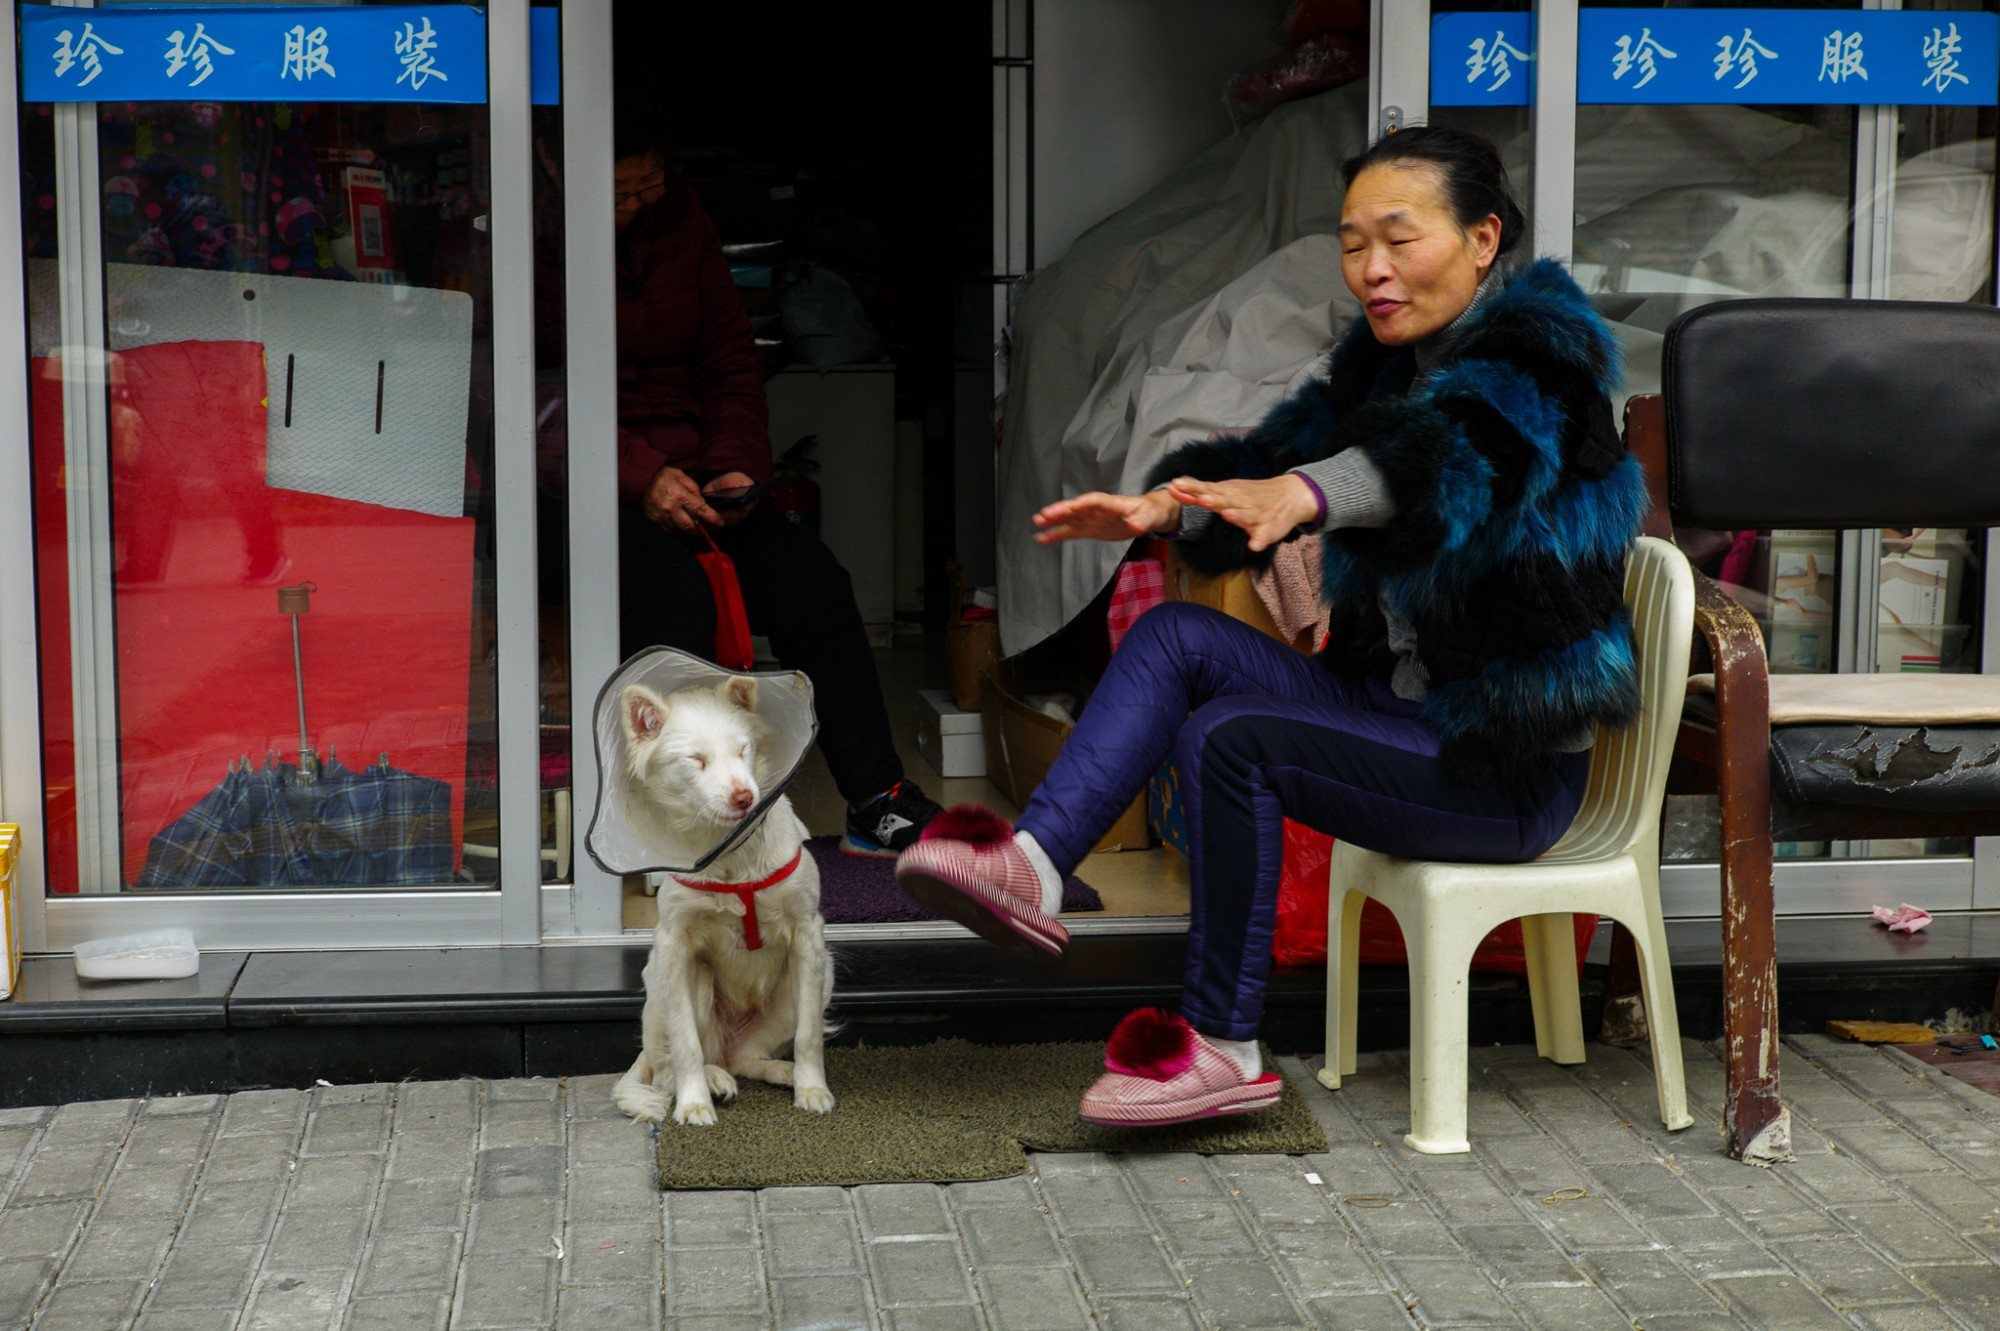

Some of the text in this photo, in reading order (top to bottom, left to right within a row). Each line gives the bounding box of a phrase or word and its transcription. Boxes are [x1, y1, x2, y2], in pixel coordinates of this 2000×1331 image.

[53, 17, 448, 91] 珍珍服装
[1465, 31, 1538, 92] 珍
[1612, 23, 1969, 93] 珍珍服装
